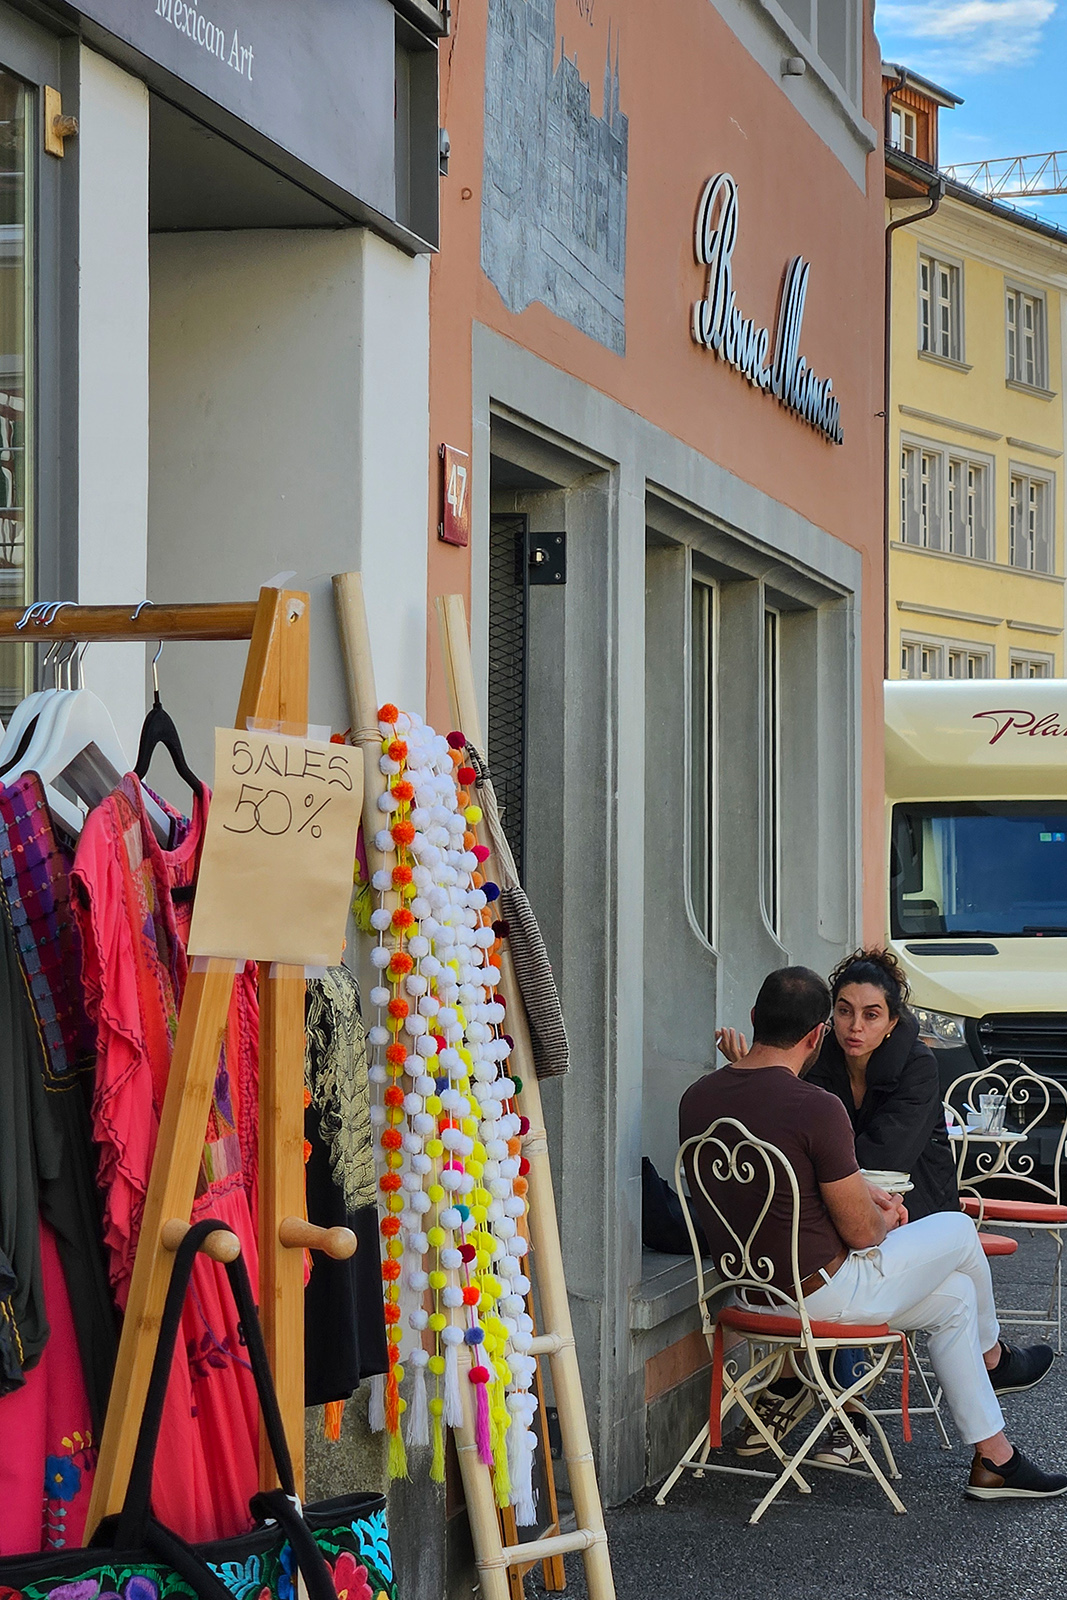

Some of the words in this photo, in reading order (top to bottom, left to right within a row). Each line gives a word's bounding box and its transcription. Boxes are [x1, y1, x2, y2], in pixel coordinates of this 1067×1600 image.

[227, 29, 254, 81] Art
[447, 463, 467, 518] 47
[972, 709, 1067, 745] Pla
[232, 740, 353, 791] SALES
[222, 783, 332, 838] 50%
